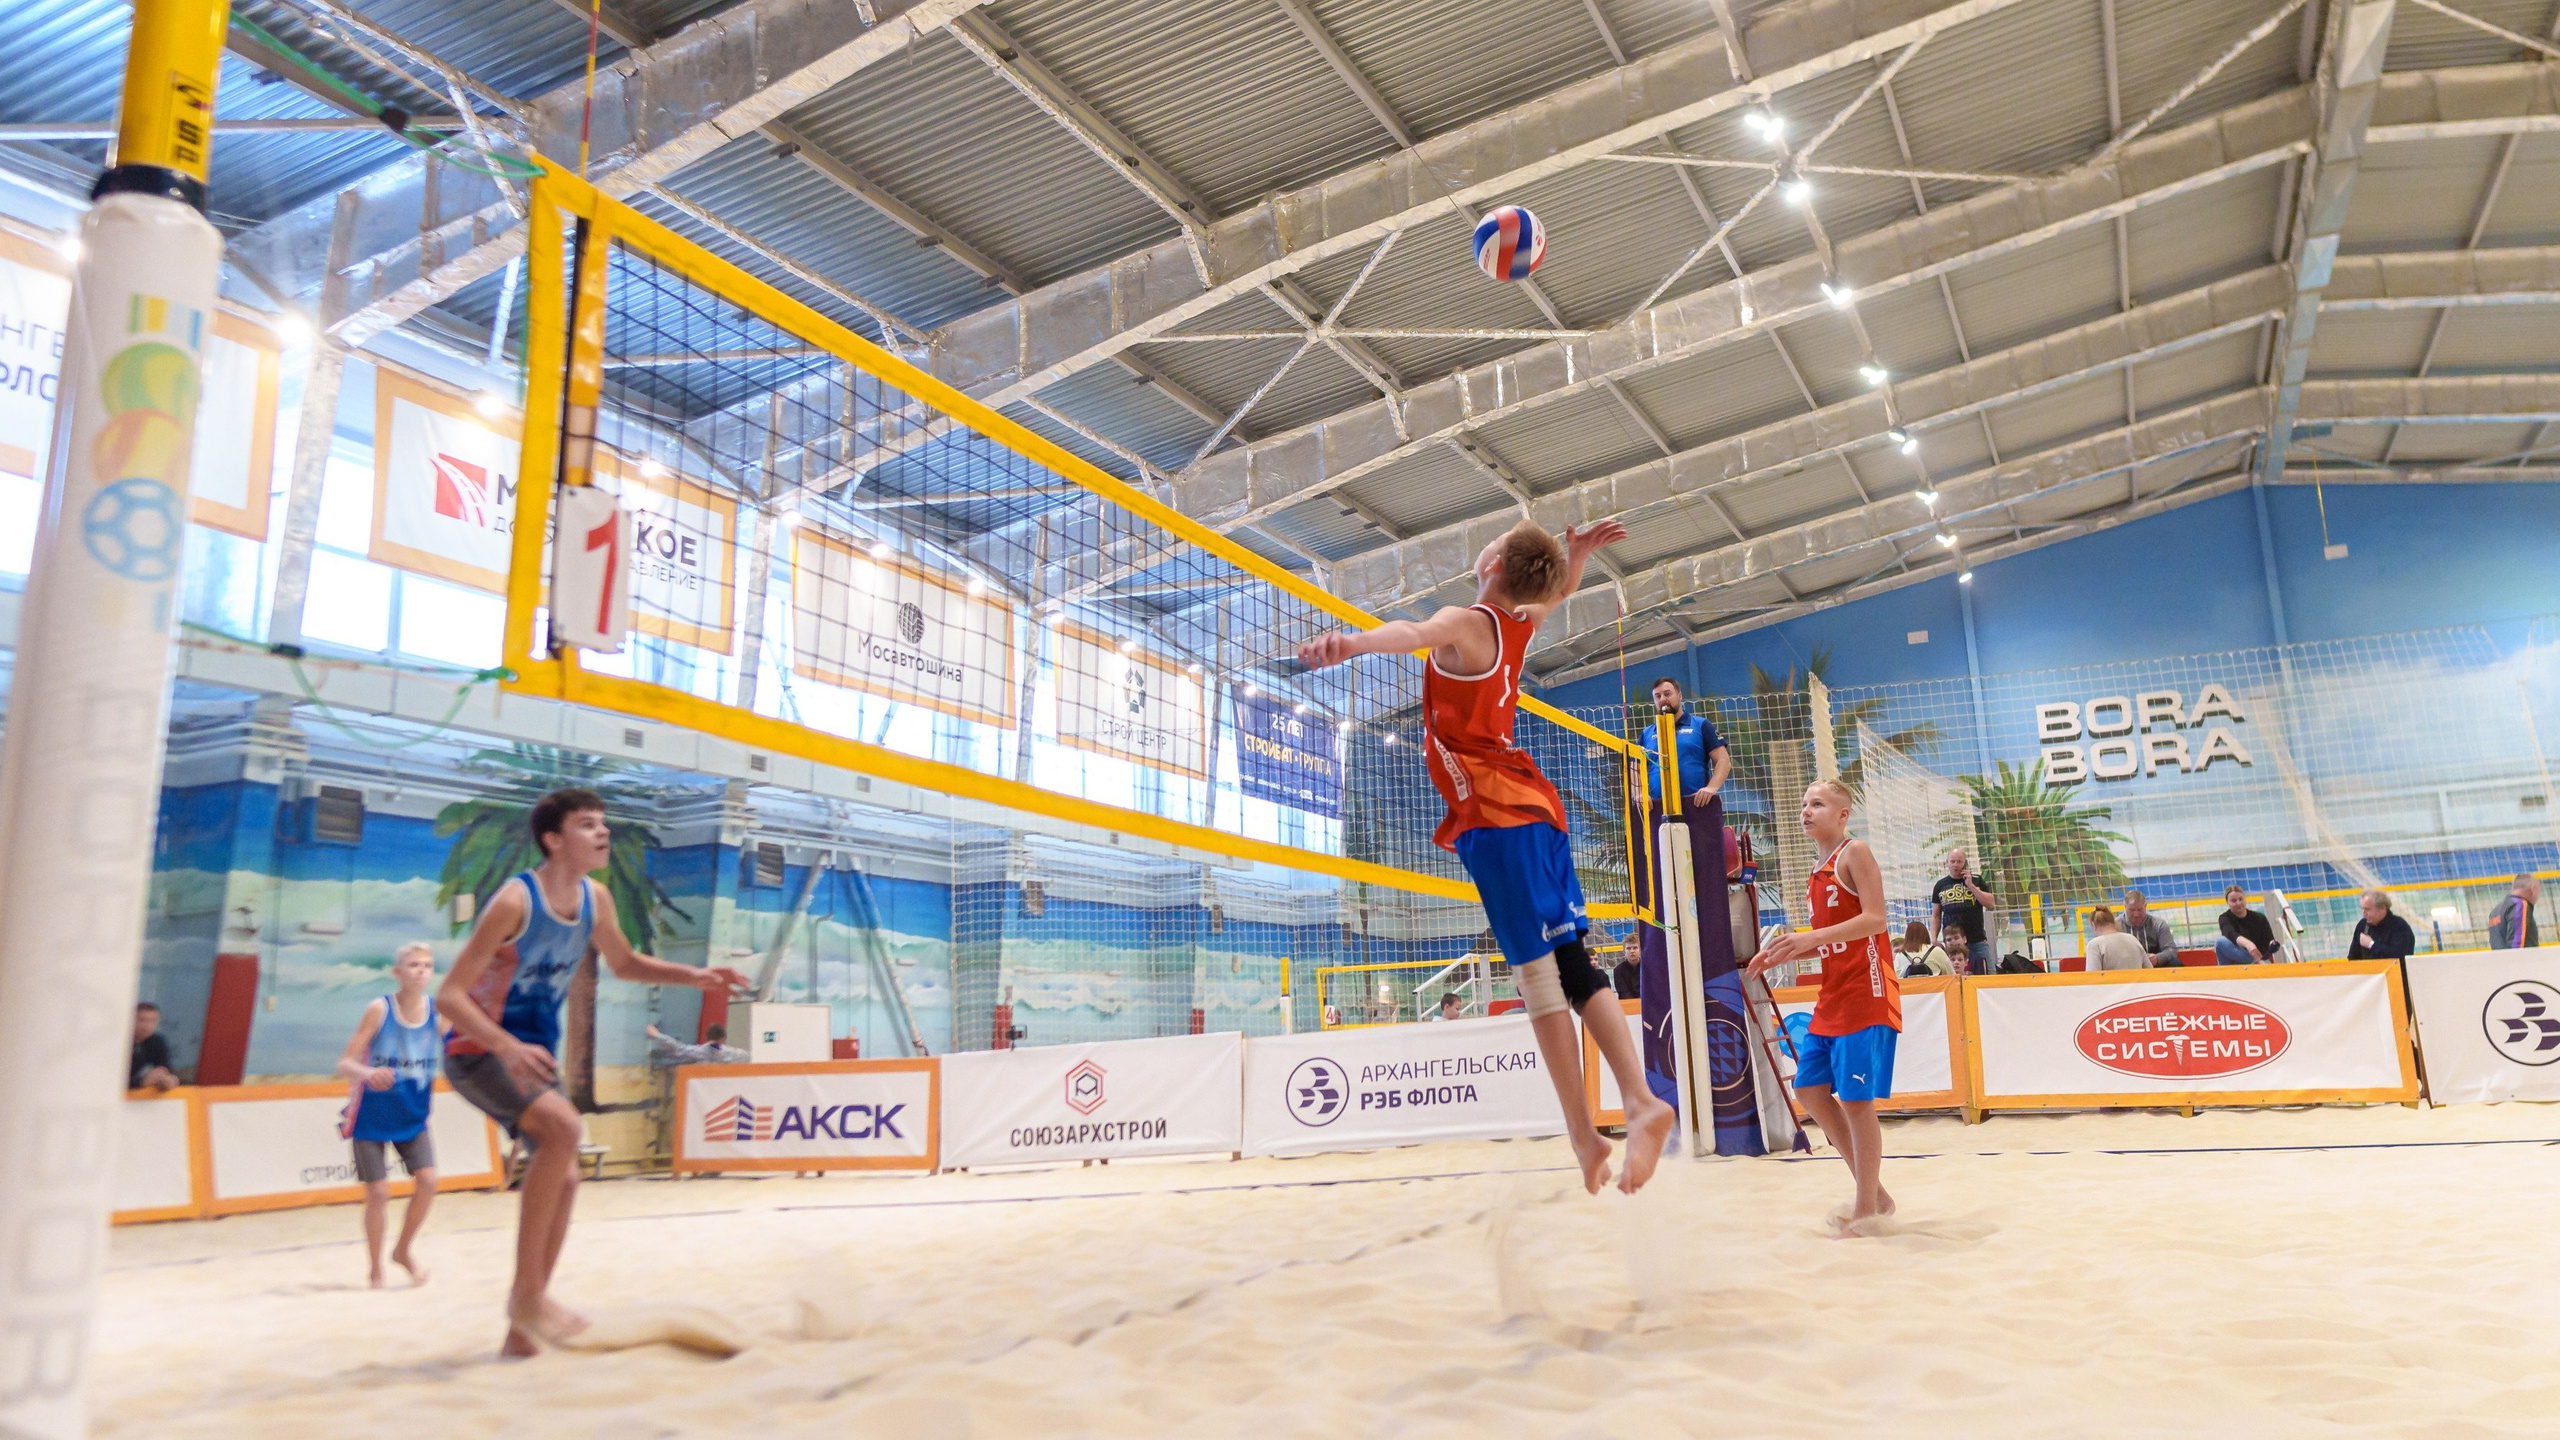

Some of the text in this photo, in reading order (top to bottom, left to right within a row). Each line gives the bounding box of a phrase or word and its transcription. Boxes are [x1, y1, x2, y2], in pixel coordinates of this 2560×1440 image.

[585, 509, 618, 635] 1
[858, 631, 963, 683] Мосавтошина
[1272, 713, 1304, 738] 25 ЛЕТ
[2036, 683, 2245, 744] BORA
[2041, 727, 2252, 788] BORA
[1826, 884, 1839, 907] 2
[1326, 1007, 1334, 1022] 4
[2095, 1012, 2267, 1034] КРЕПЁЖНЫЕ
[2097, 1034, 2271, 1066] СИСТЕМЫ
[1361, 1051, 1537, 1083] АРХАНГЕЛЬСКАЯ
[1361, 1084, 1478, 1110] РЭБ ФЛОТА
[774, 1103, 907, 1140] АКСК
[1010, 1117, 1167, 1147] СОЮЗАРХСТРОЙ
